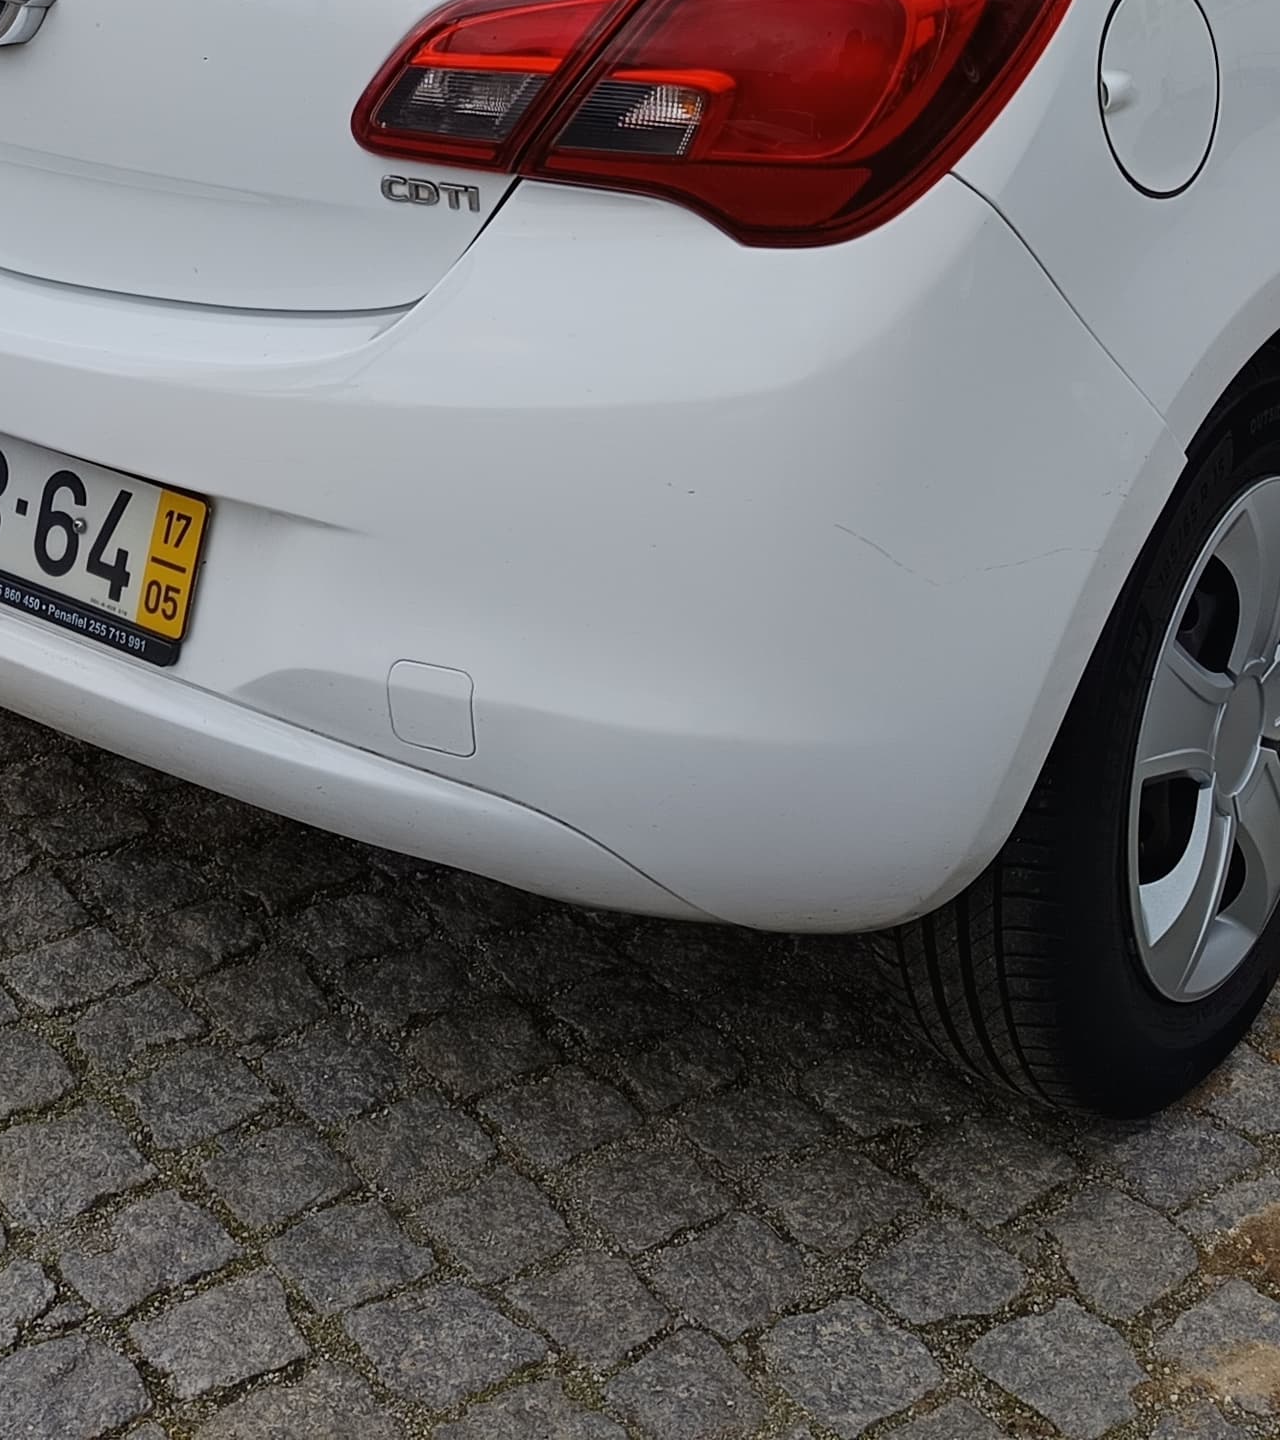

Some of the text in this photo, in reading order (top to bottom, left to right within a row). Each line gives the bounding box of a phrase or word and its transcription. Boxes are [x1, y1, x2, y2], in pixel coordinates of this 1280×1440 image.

[381, 174, 480, 212] CDTI
[163, 509, 192, 548] 17
[4, 587, 21, 603] 860
[23, 594, 40, 611] 450
[48, 603, 87, 629] Penafiel
[88, 620, 107, 637] 255
[108, 627, 126, 644] 713
[128, 635, 146, 652] 991
[144, 579, 181, 621] 05
